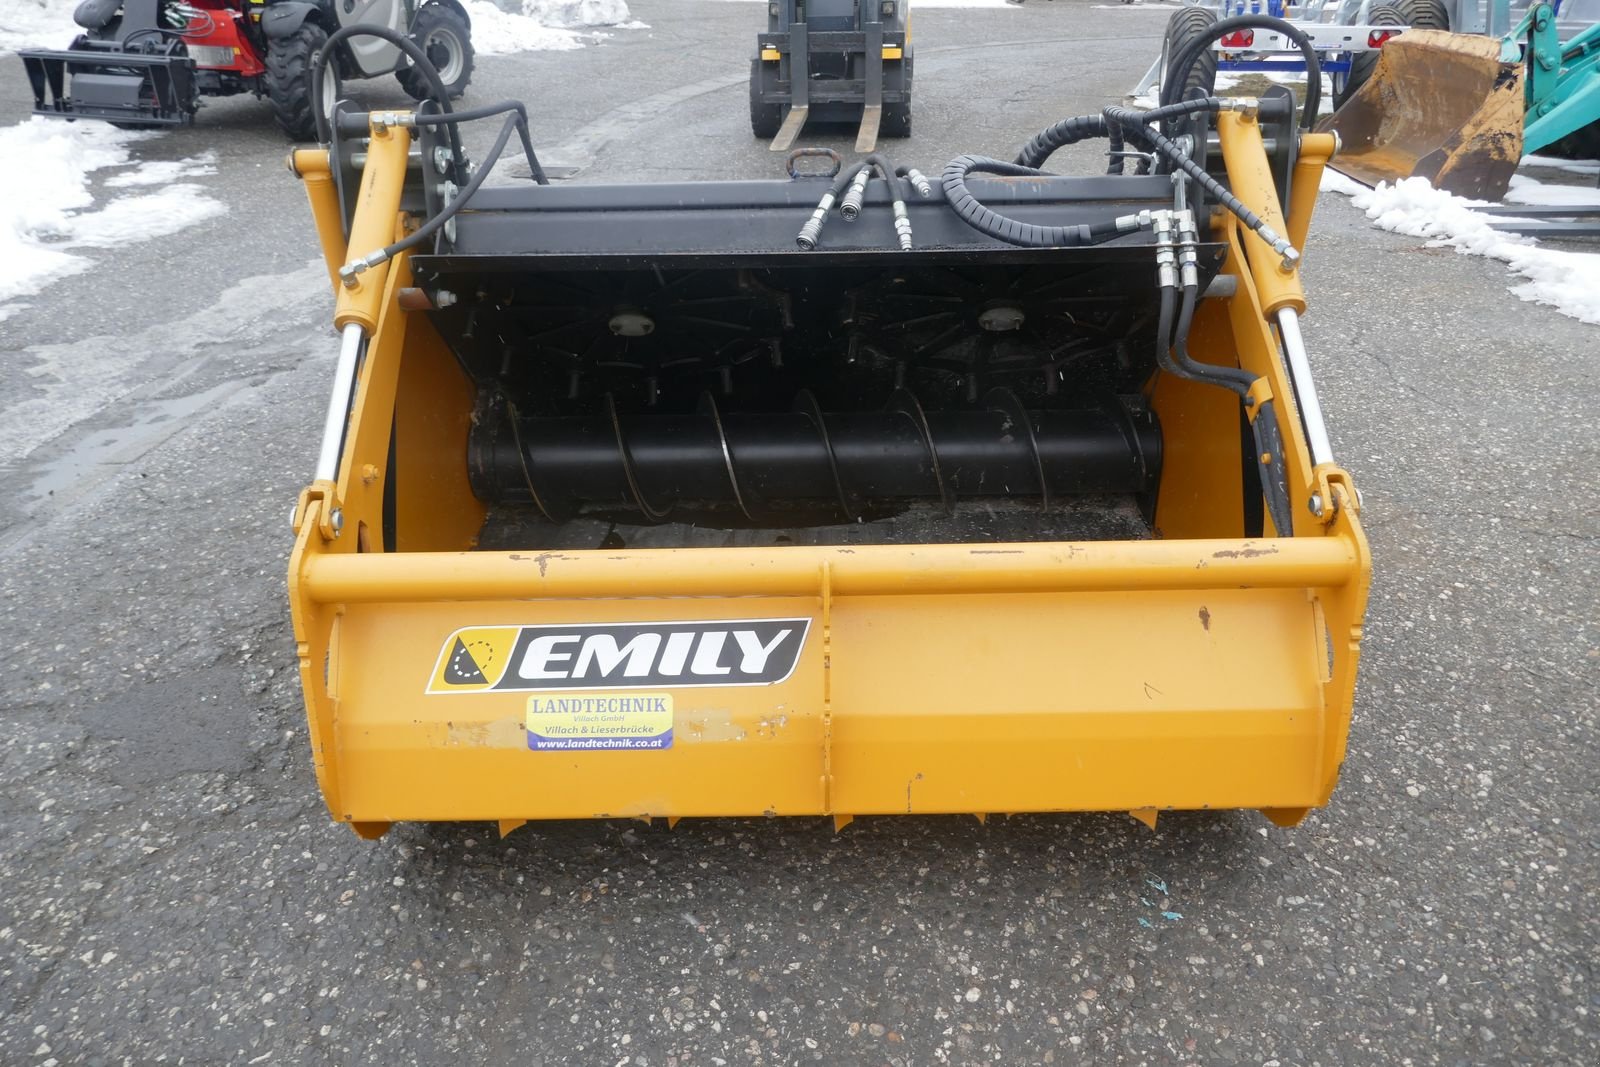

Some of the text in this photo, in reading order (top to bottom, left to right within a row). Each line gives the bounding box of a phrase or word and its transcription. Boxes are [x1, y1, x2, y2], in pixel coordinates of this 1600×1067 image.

[518, 629, 792, 680] EMILY
[532, 698, 666, 714] LANDTECHNIK
[545, 725, 654, 734] Villach & Lieserbrücke
[537, 739, 662, 749] www.landtechnik.co.at
